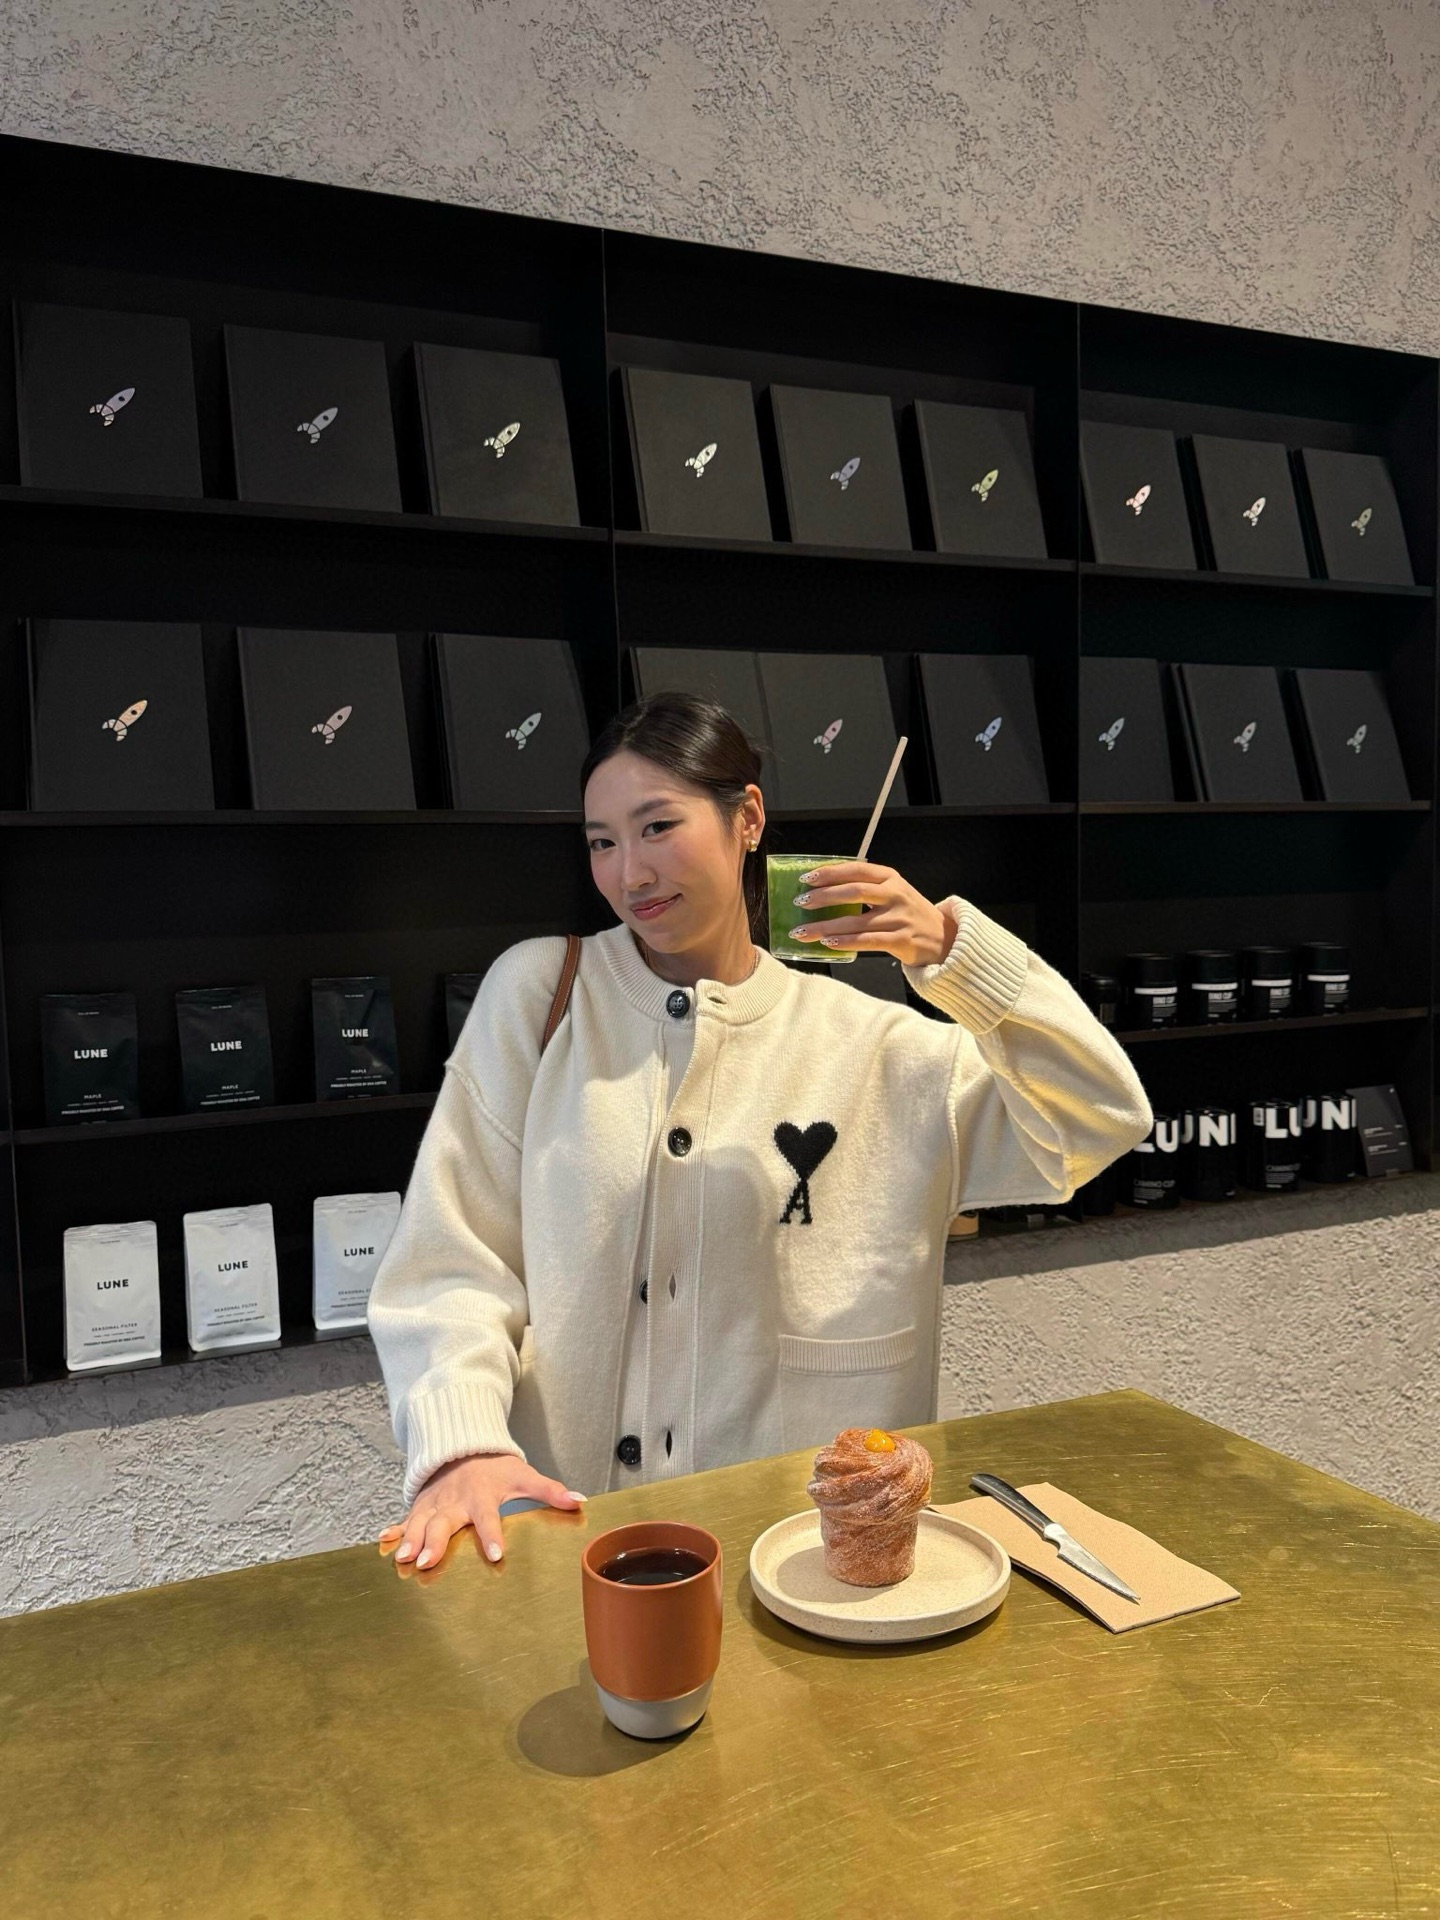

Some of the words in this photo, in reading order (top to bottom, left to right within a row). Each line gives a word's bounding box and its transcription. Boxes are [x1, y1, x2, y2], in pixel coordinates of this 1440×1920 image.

[341, 1028, 369, 1038] LUNE
[210, 1040, 243, 1052] LUNE
[74, 1048, 109, 1060] LUNE
[343, 1246, 375, 1257] LUNE
[217, 1260, 249, 1272] LUNE
[97, 1279, 129, 1290] LUNE
[91, 1324, 120, 1332] SEASONAL
